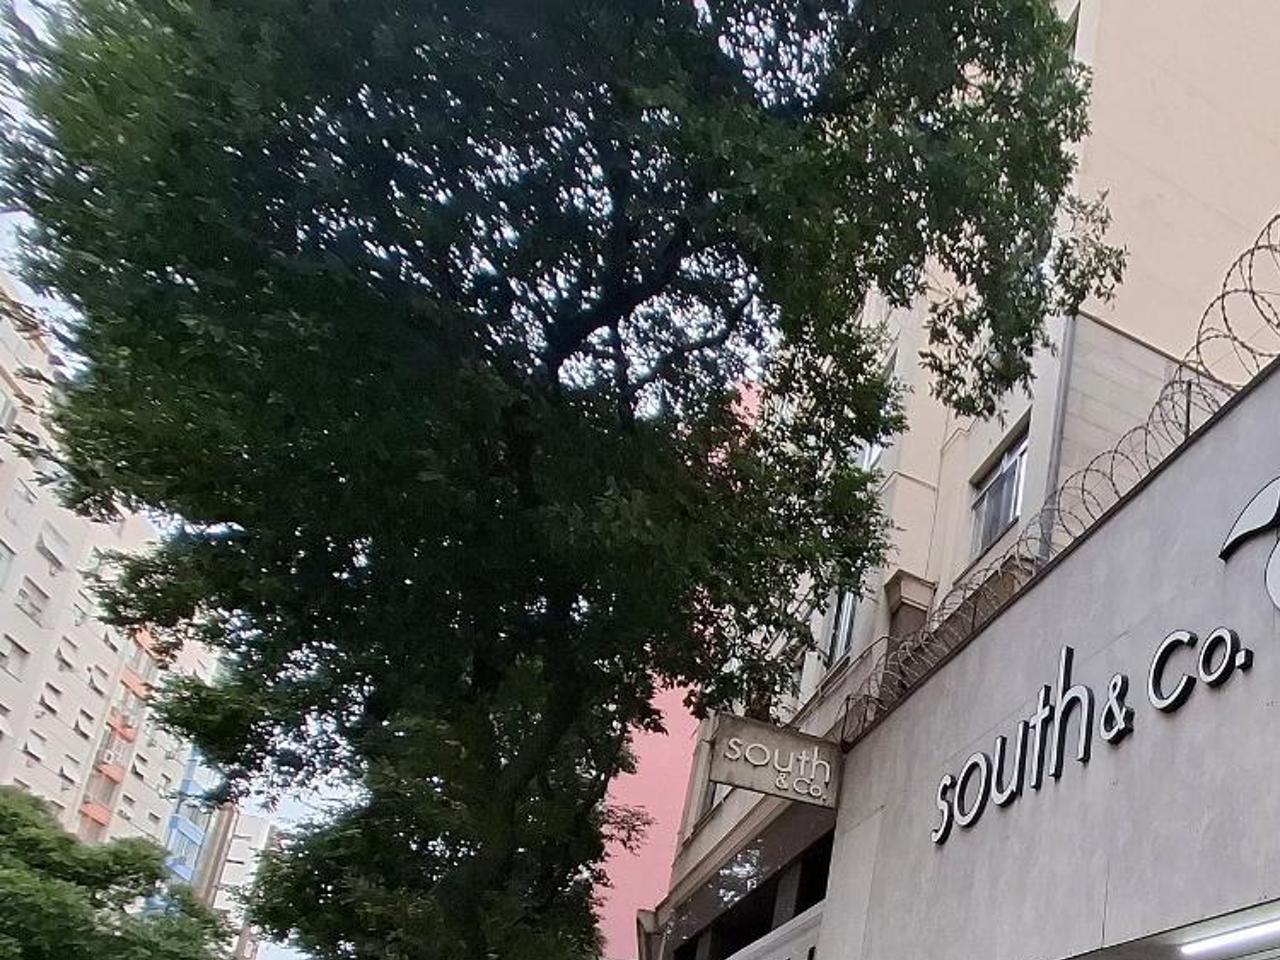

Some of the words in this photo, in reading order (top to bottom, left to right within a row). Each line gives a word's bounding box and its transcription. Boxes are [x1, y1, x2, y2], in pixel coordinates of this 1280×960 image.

[930, 645, 1095, 845] south
[1100, 673, 1135, 744] &
[1148, 626, 1254, 712] Co.
[725, 738, 831, 784] south
[793, 777, 827, 801] Co.
